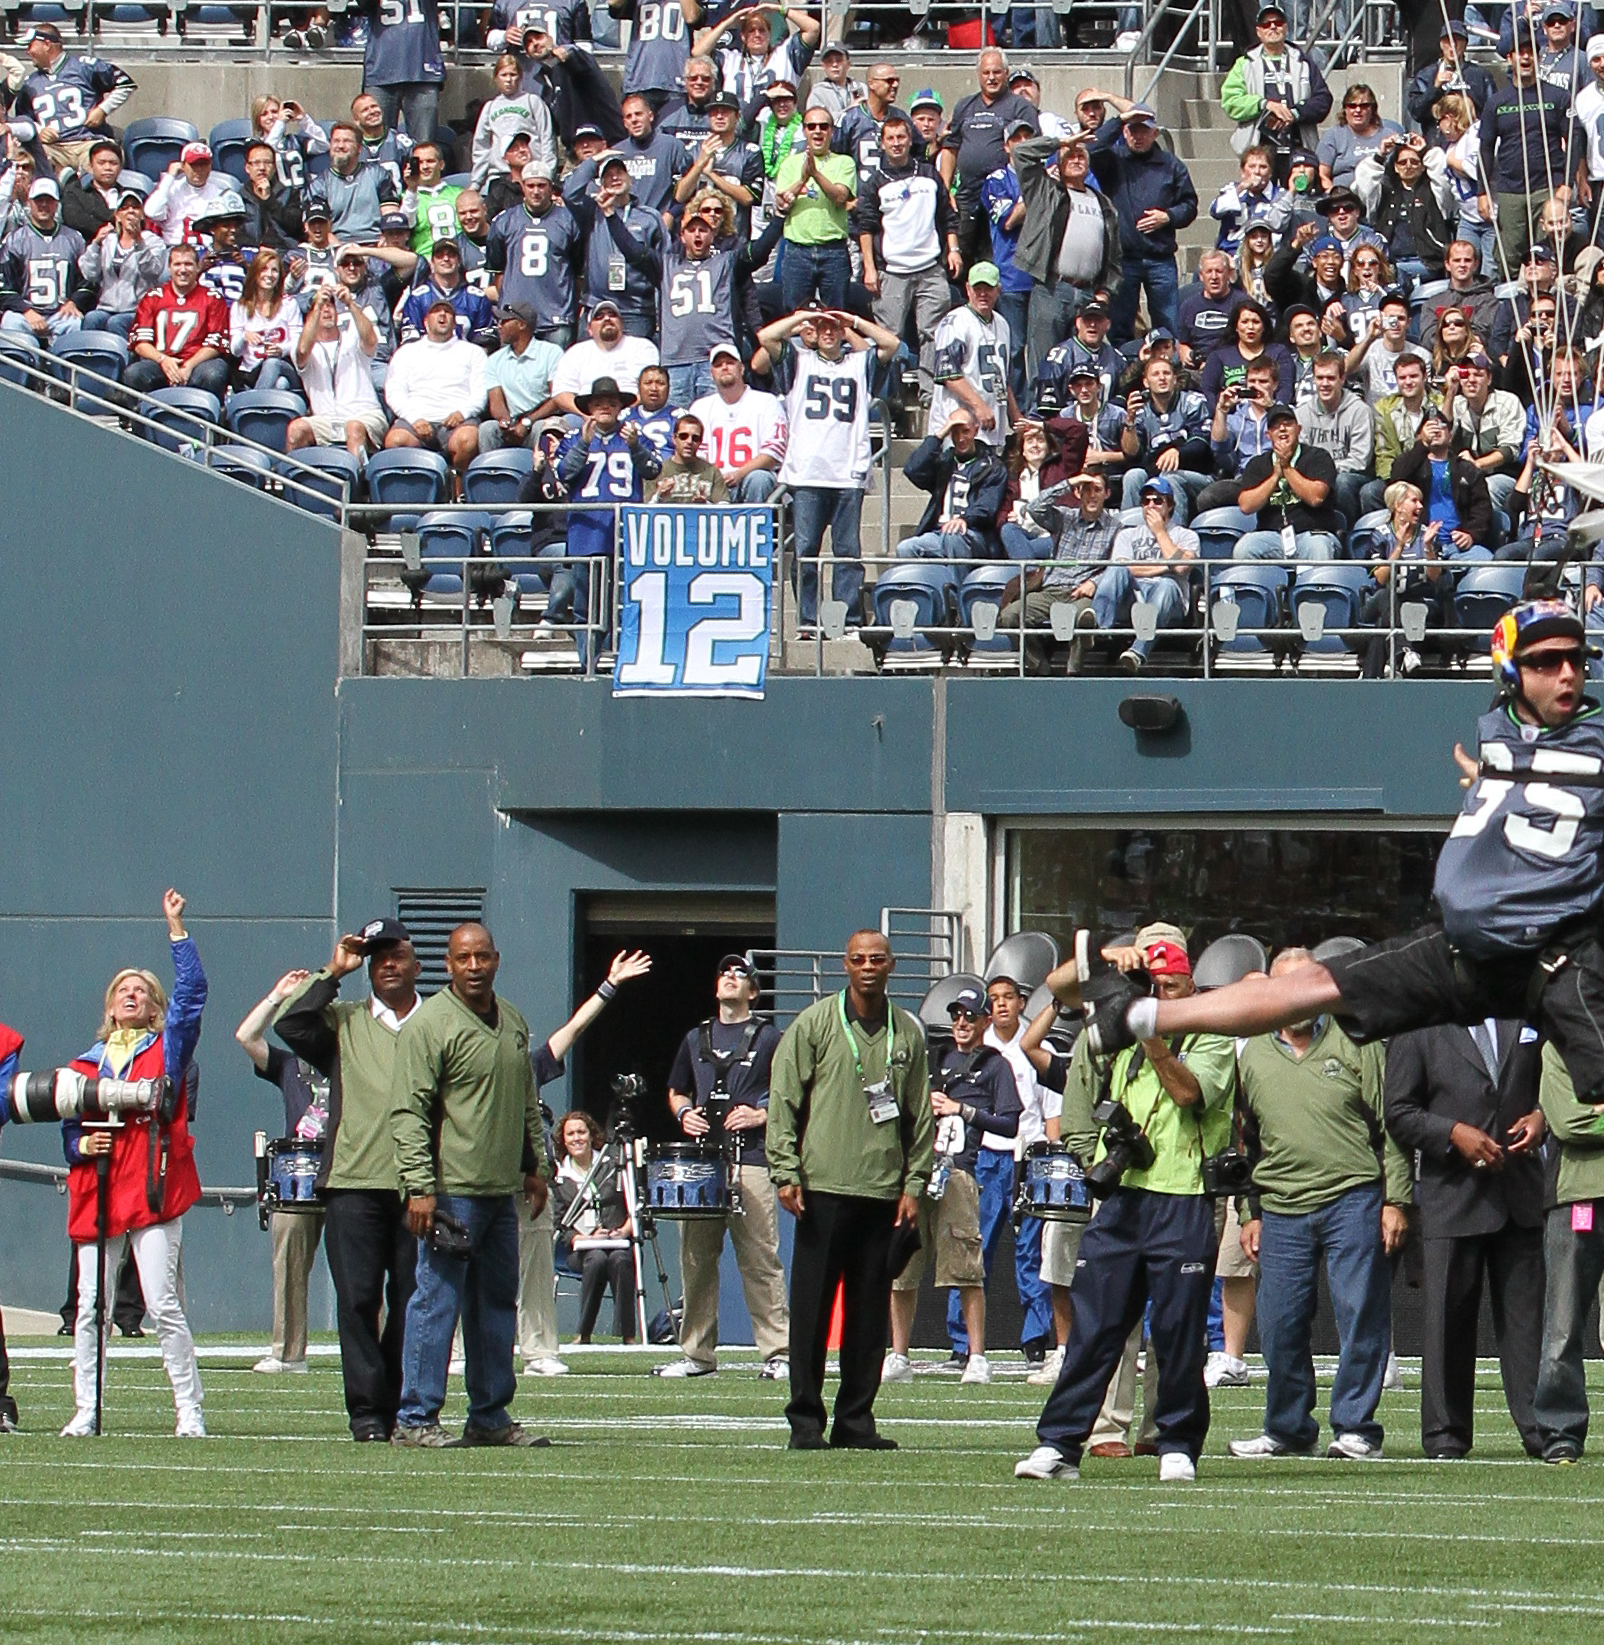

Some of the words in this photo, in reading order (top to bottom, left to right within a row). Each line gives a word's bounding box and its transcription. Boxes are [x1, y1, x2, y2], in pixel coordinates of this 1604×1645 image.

[639, 2, 685, 42] 80
[33, 87, 87, 133] 23
[427, 203, 457, 242] 8
[521, 234, 550, 277] 8
[28, 259, 70, 306] 51
[670, 270, 716, 318] 51
[155, 310, 199, 353] 17
[805, 375, 858, 424] 59
[712, 427, 753, 469] 16
[581, 451, 634, 498] 79
[627, 513, 768, 567] VOLUME
[619, 572, 765, 684] 12
